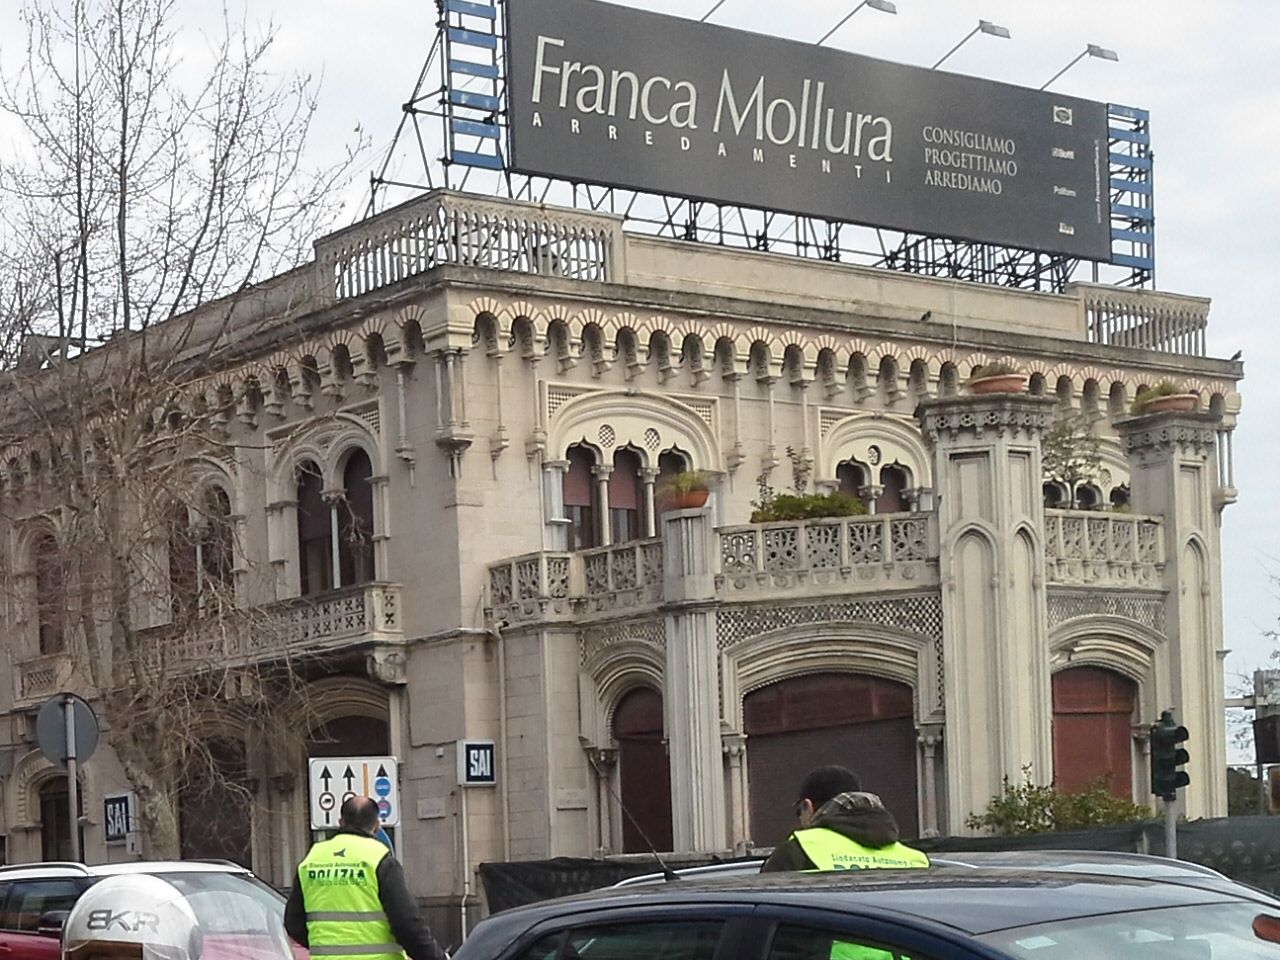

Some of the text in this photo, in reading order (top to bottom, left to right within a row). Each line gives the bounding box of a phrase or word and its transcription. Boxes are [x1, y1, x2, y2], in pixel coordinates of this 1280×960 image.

[531, 35, 894, 162] Franca Mollura
[531, 111, 892, 184] ARREDAMENTI
[922, 126, 1016, 155] CONSIGLIAMO
[924, 148, 1018, 176] PROGETTIAMO
[924, 169, 1002, 195] ARREDIAMO
[469, 749, 491, 777] SAI
[107, 802, 127, 836] SAI
[86, 909, 161, 935] BKR
